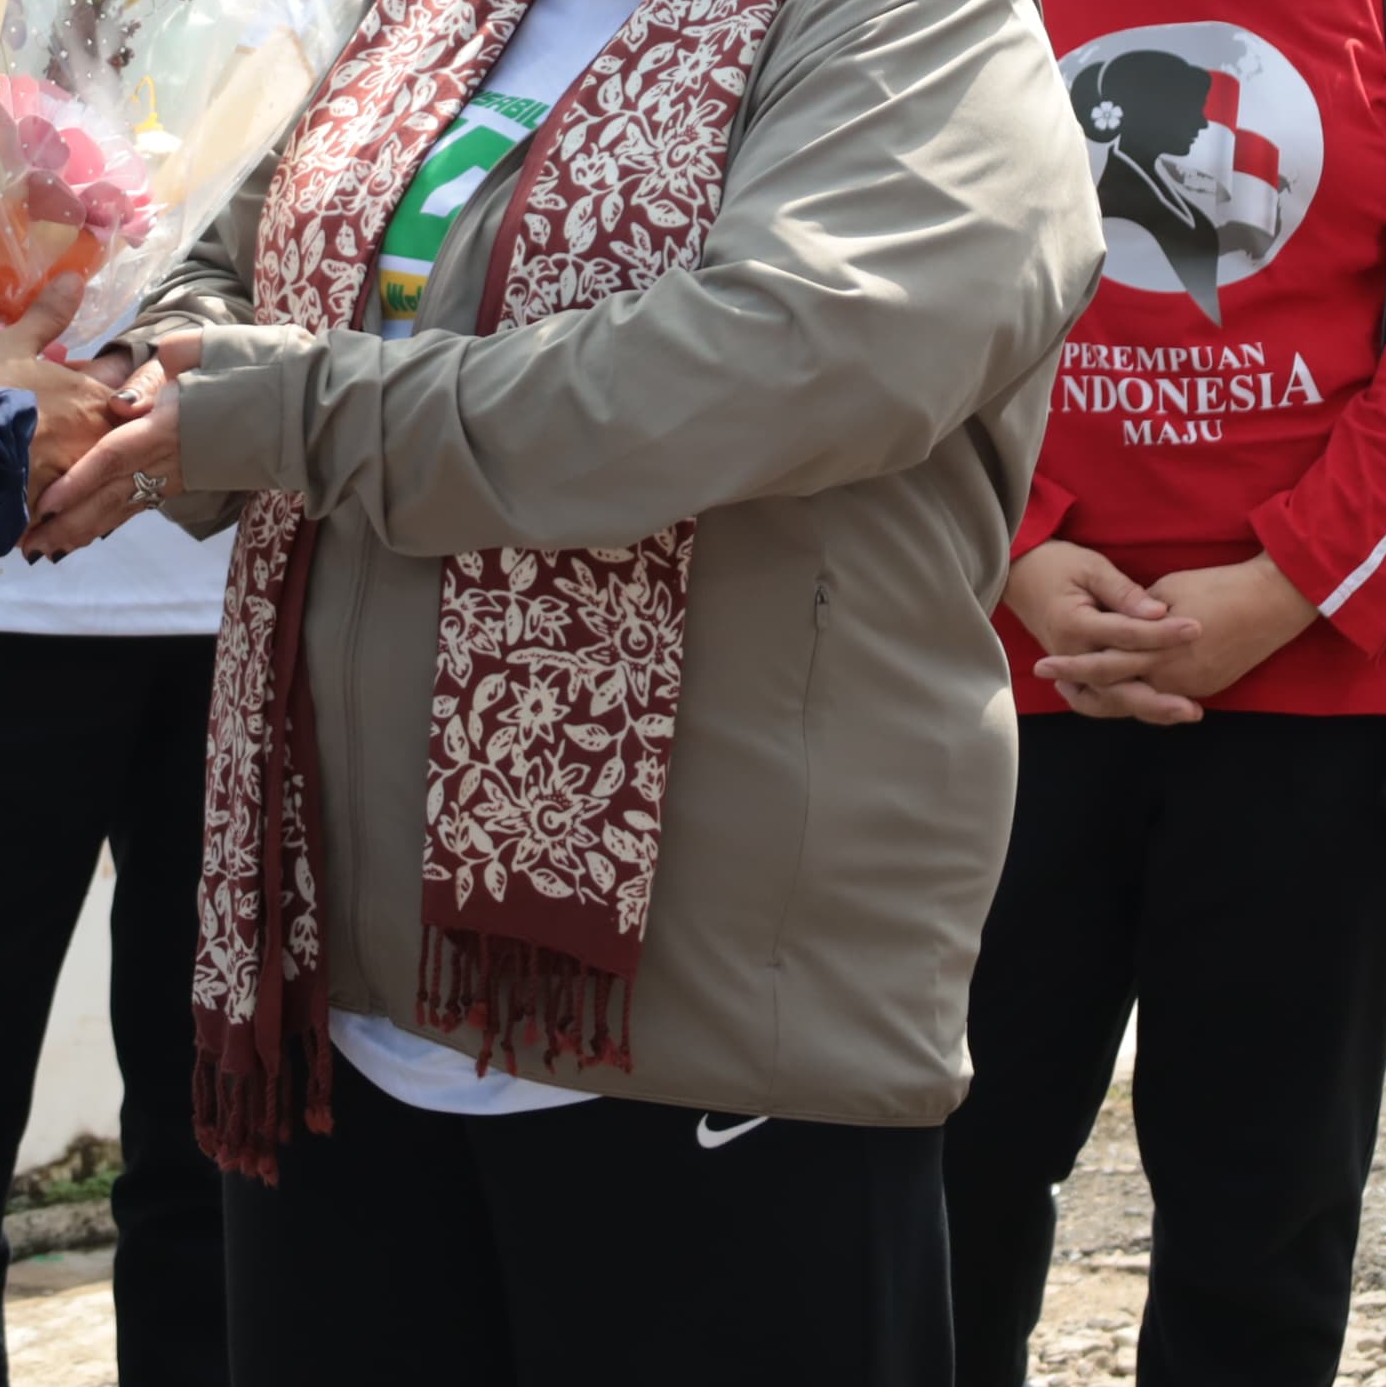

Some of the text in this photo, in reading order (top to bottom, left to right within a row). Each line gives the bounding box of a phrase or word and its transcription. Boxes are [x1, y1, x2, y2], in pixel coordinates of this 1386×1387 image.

[1063, 340, 1266, 373] PEREMPUAN
[1048, 351, 1325, 415] NDONESIA
[1122, 418, 1224, 447] MAJU
